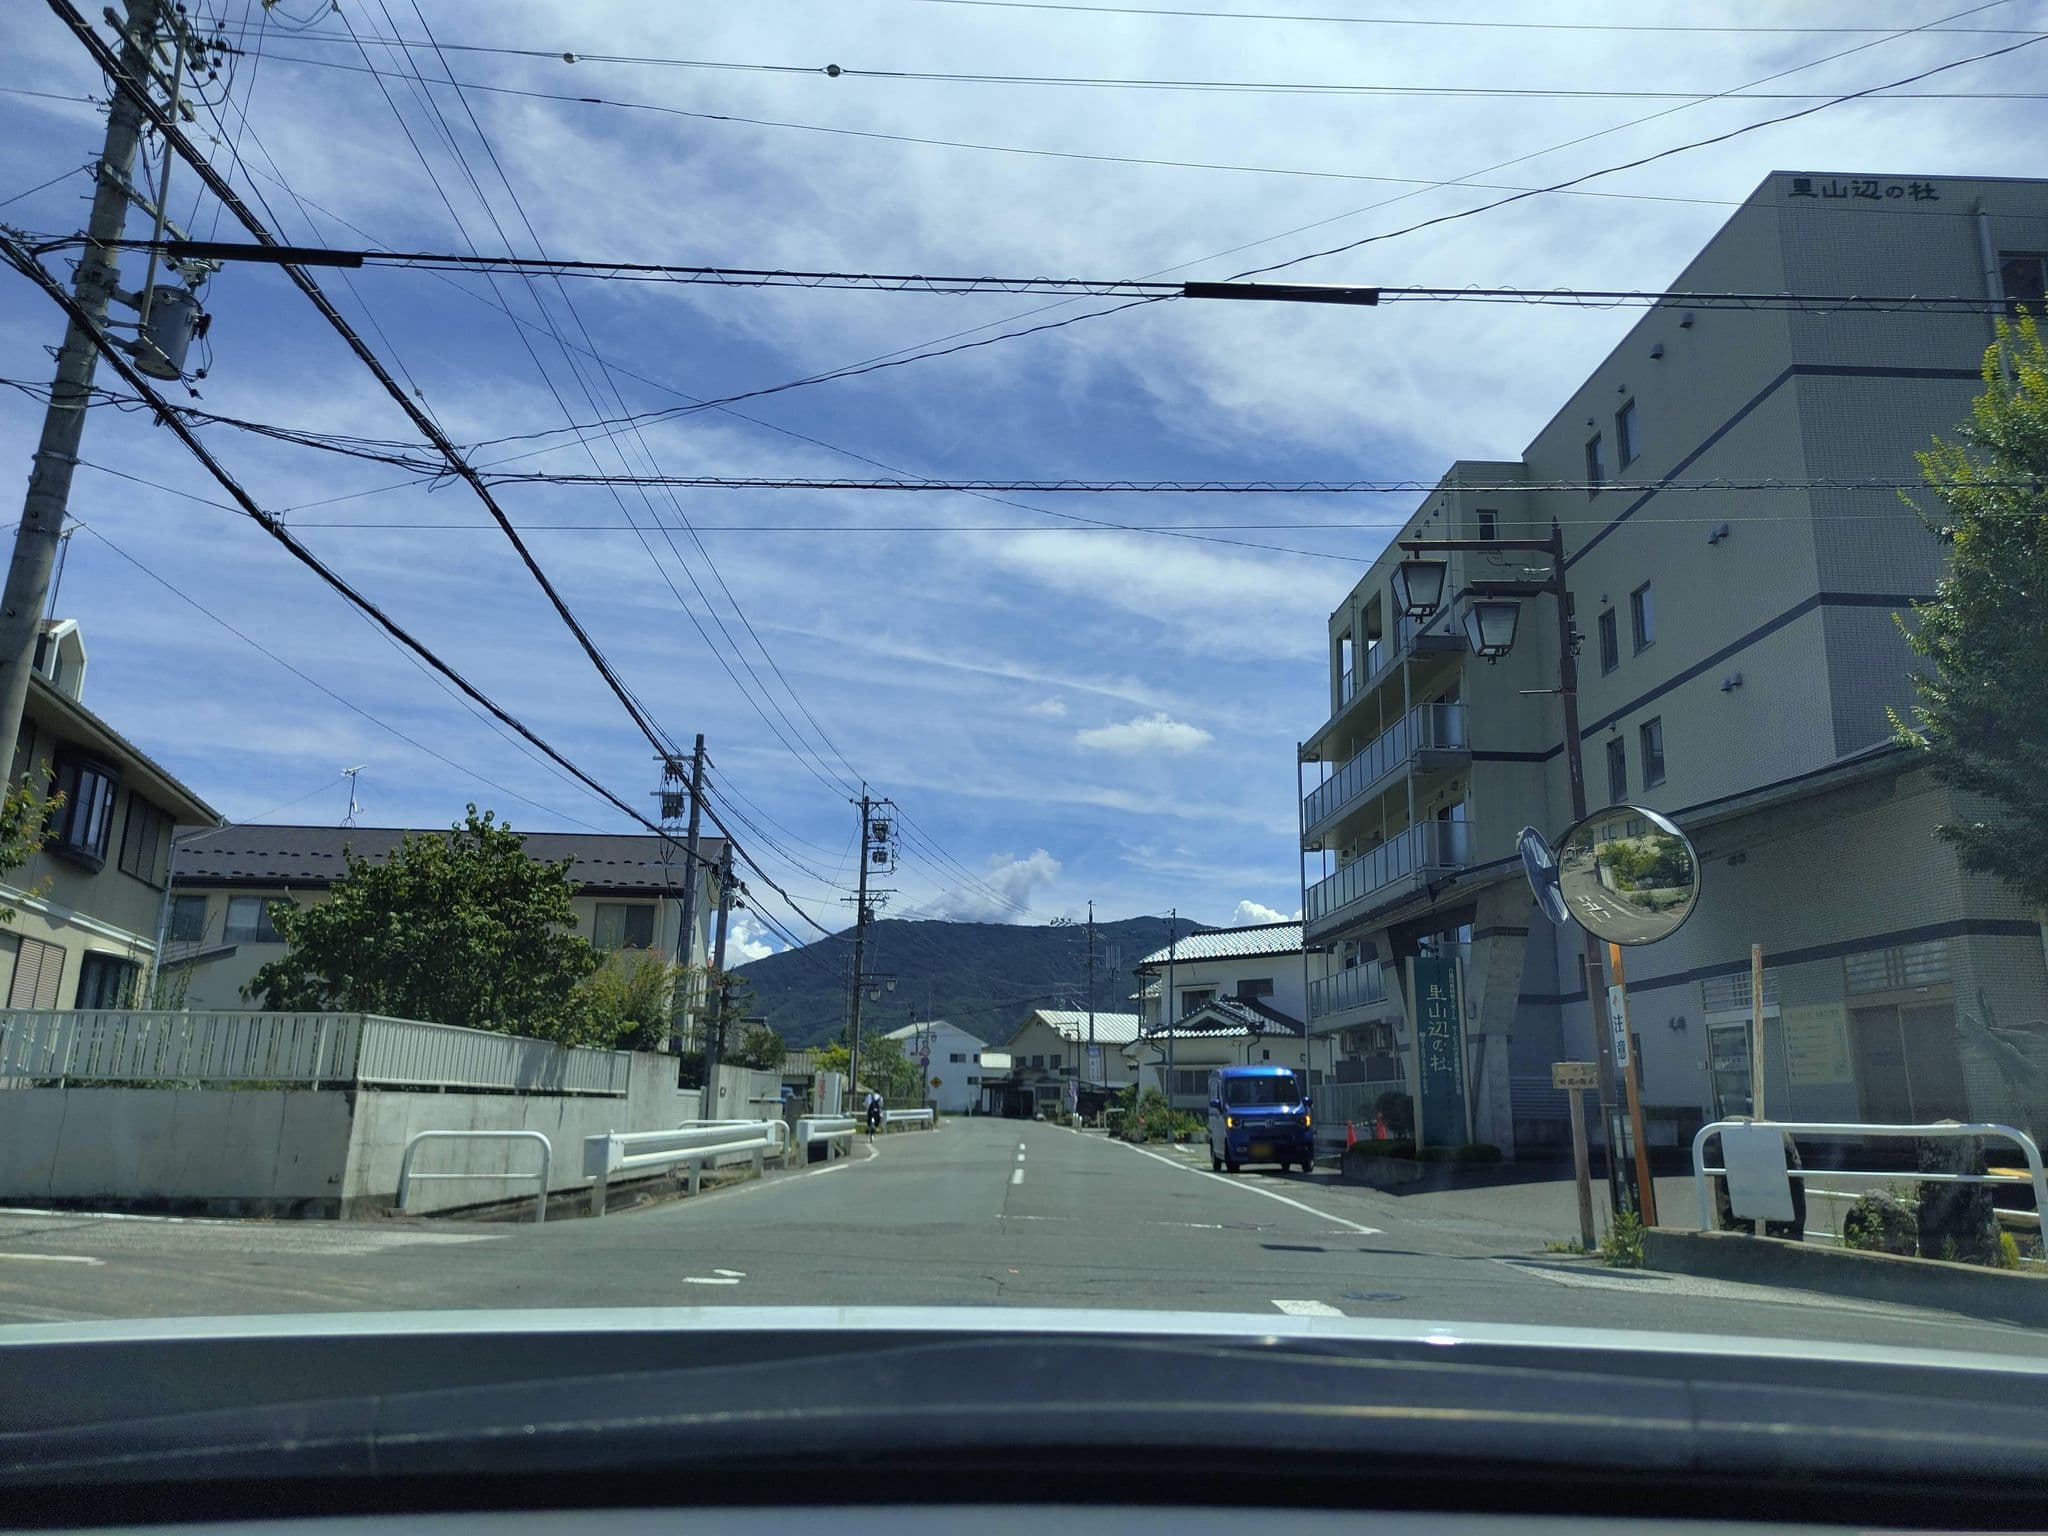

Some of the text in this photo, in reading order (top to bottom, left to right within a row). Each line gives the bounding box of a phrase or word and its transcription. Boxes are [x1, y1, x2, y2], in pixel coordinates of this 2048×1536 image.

[1788, 178, 1939, 201] 里山辺の杜
[1426, 984, 1452, 1072] 里山辺の杜
